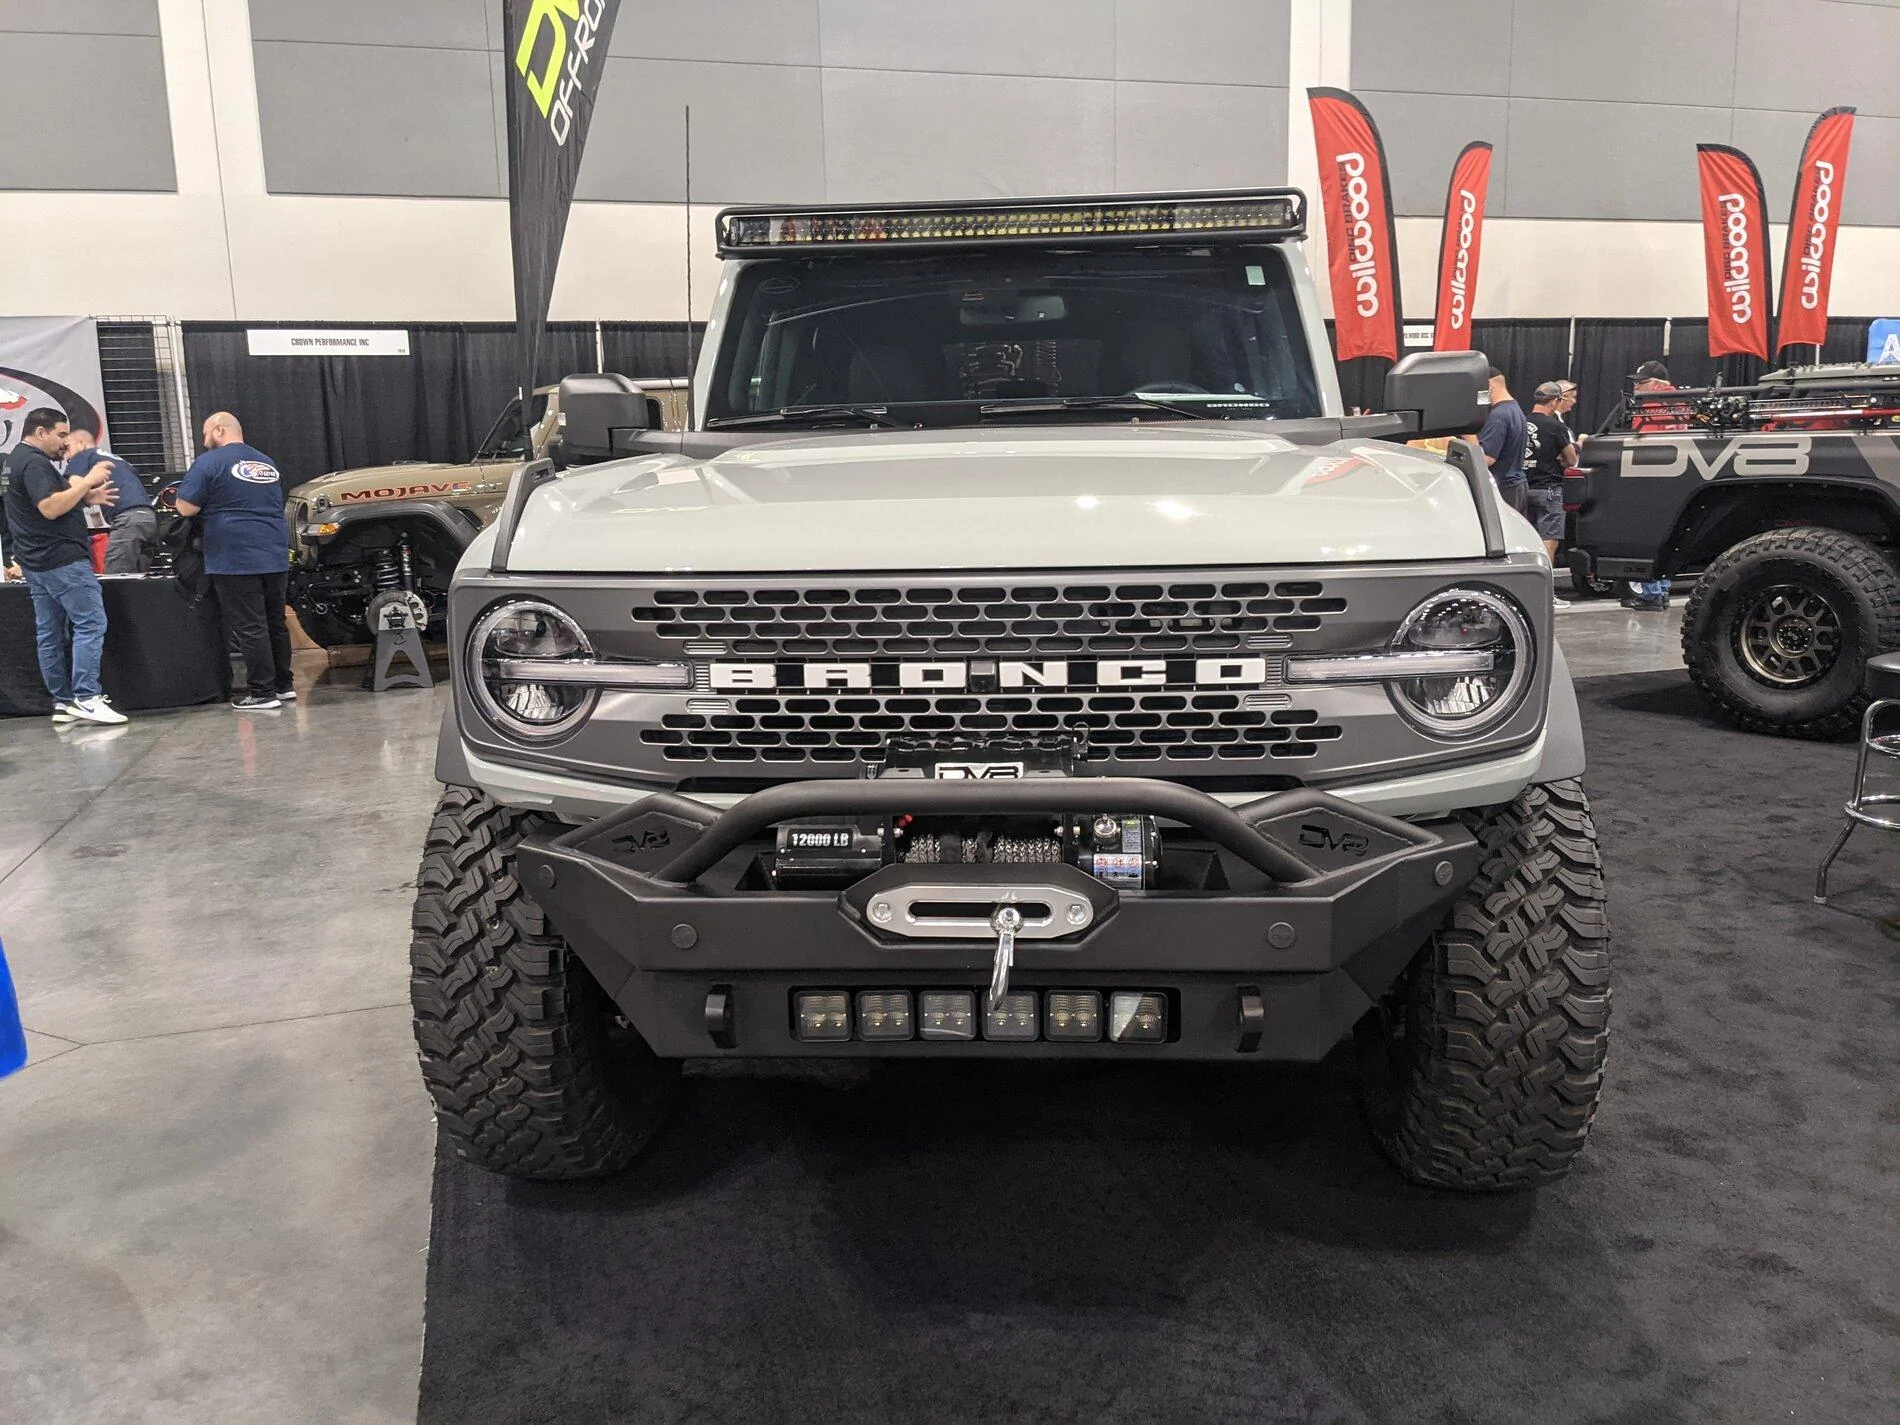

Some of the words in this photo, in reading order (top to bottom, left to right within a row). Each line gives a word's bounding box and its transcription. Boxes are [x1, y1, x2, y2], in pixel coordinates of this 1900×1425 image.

[1336, 152, 1379, 318] wilwood
[1801, 160, 1834, 310] wilwood
[1451, 189, 1476, 330] wilwood
[1718, 193, 1752, 324] wilwood
[291, 338, 313, 346] CROWN
[315, 338, 357, 346] PERFORMANCE
[359, 338, 370, 347] INC
[1620, 437, 1812, 481] DV8
[340, 481, 472, 501] MOJAVE
[709, 658, 1266, 689] BRONCO
[791, 833, 831, 847] 12000
[833, 832, 849, 847] LB
